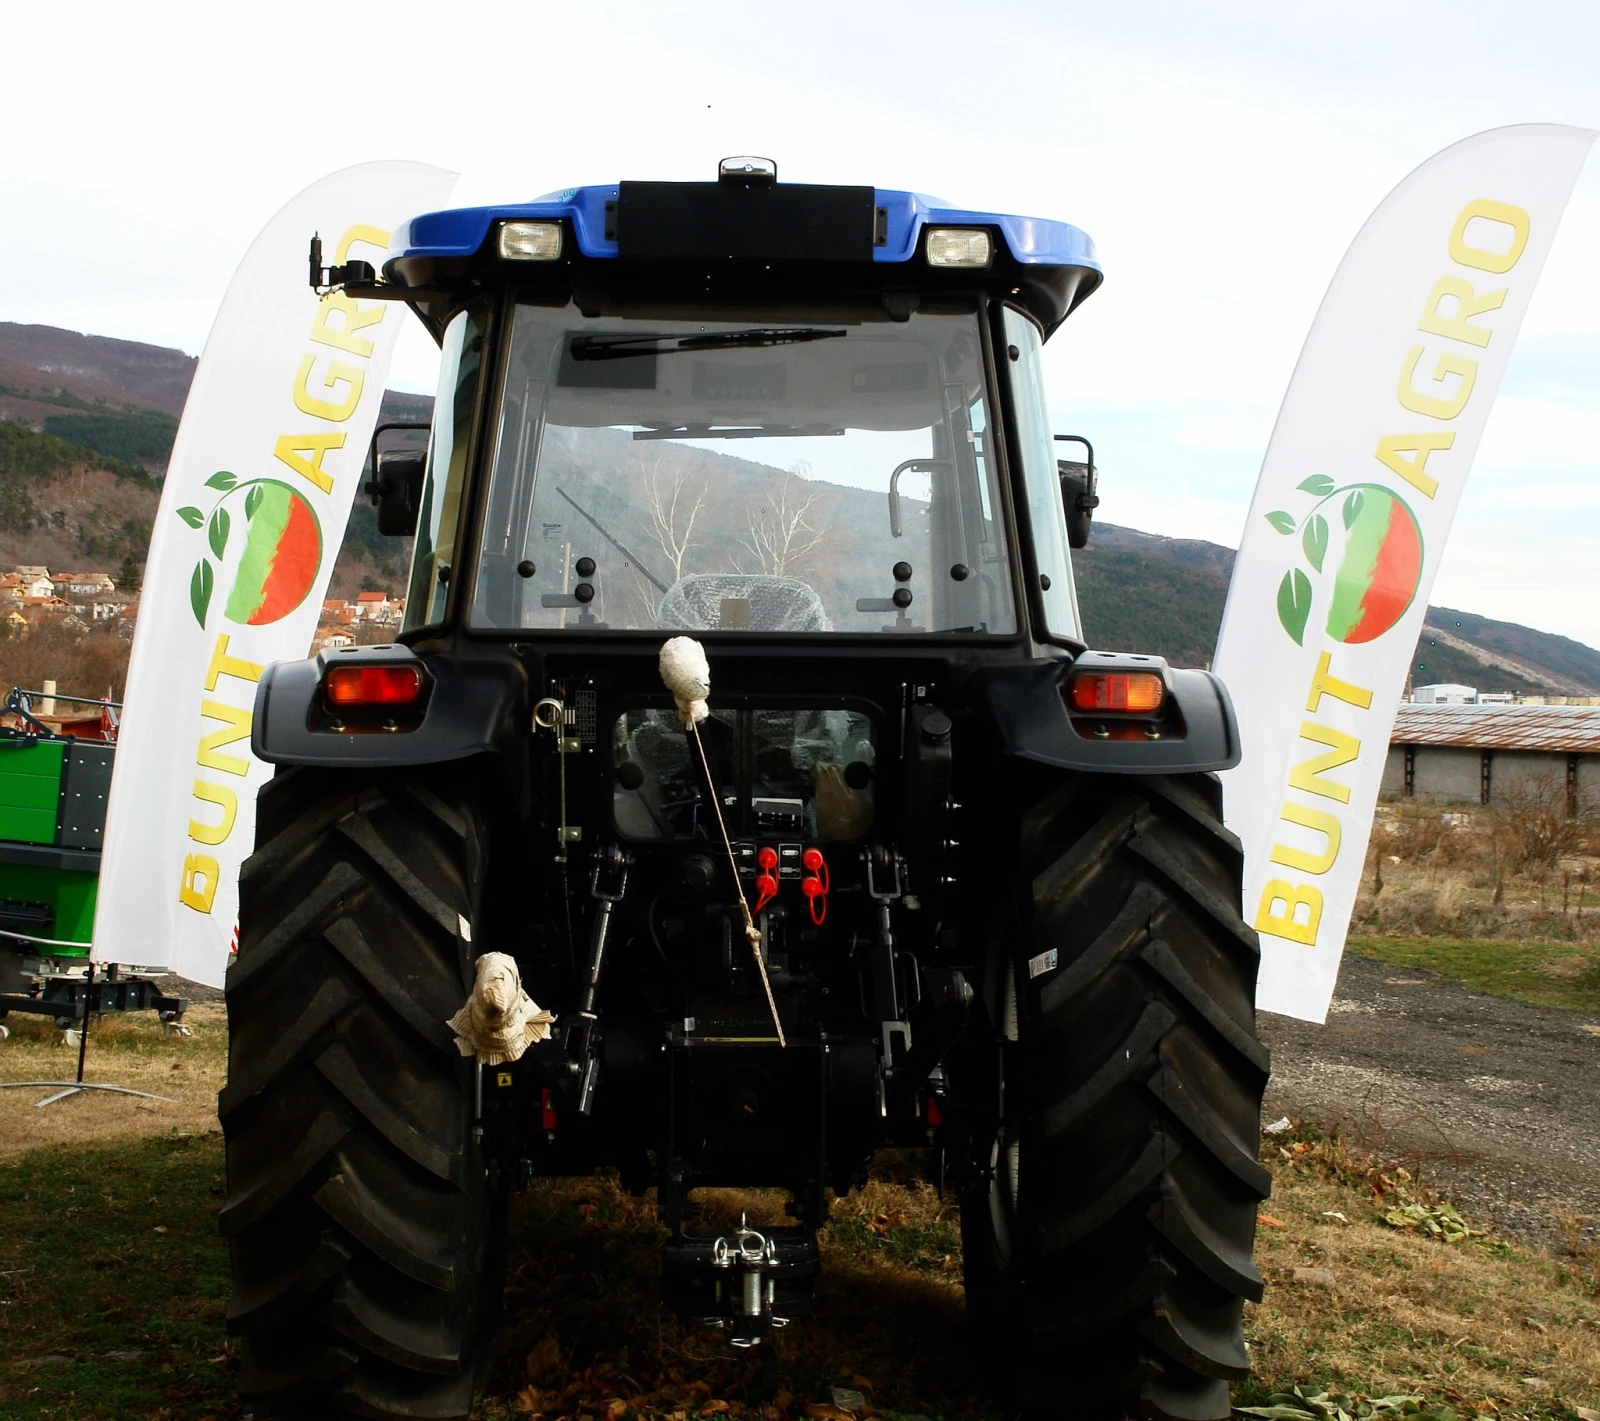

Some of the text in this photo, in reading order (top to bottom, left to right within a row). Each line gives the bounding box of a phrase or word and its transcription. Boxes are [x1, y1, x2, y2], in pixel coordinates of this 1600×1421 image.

[180, 634, 263, 913] BUNT
[1256, 198, 1530, 946] BUNT AGRO
